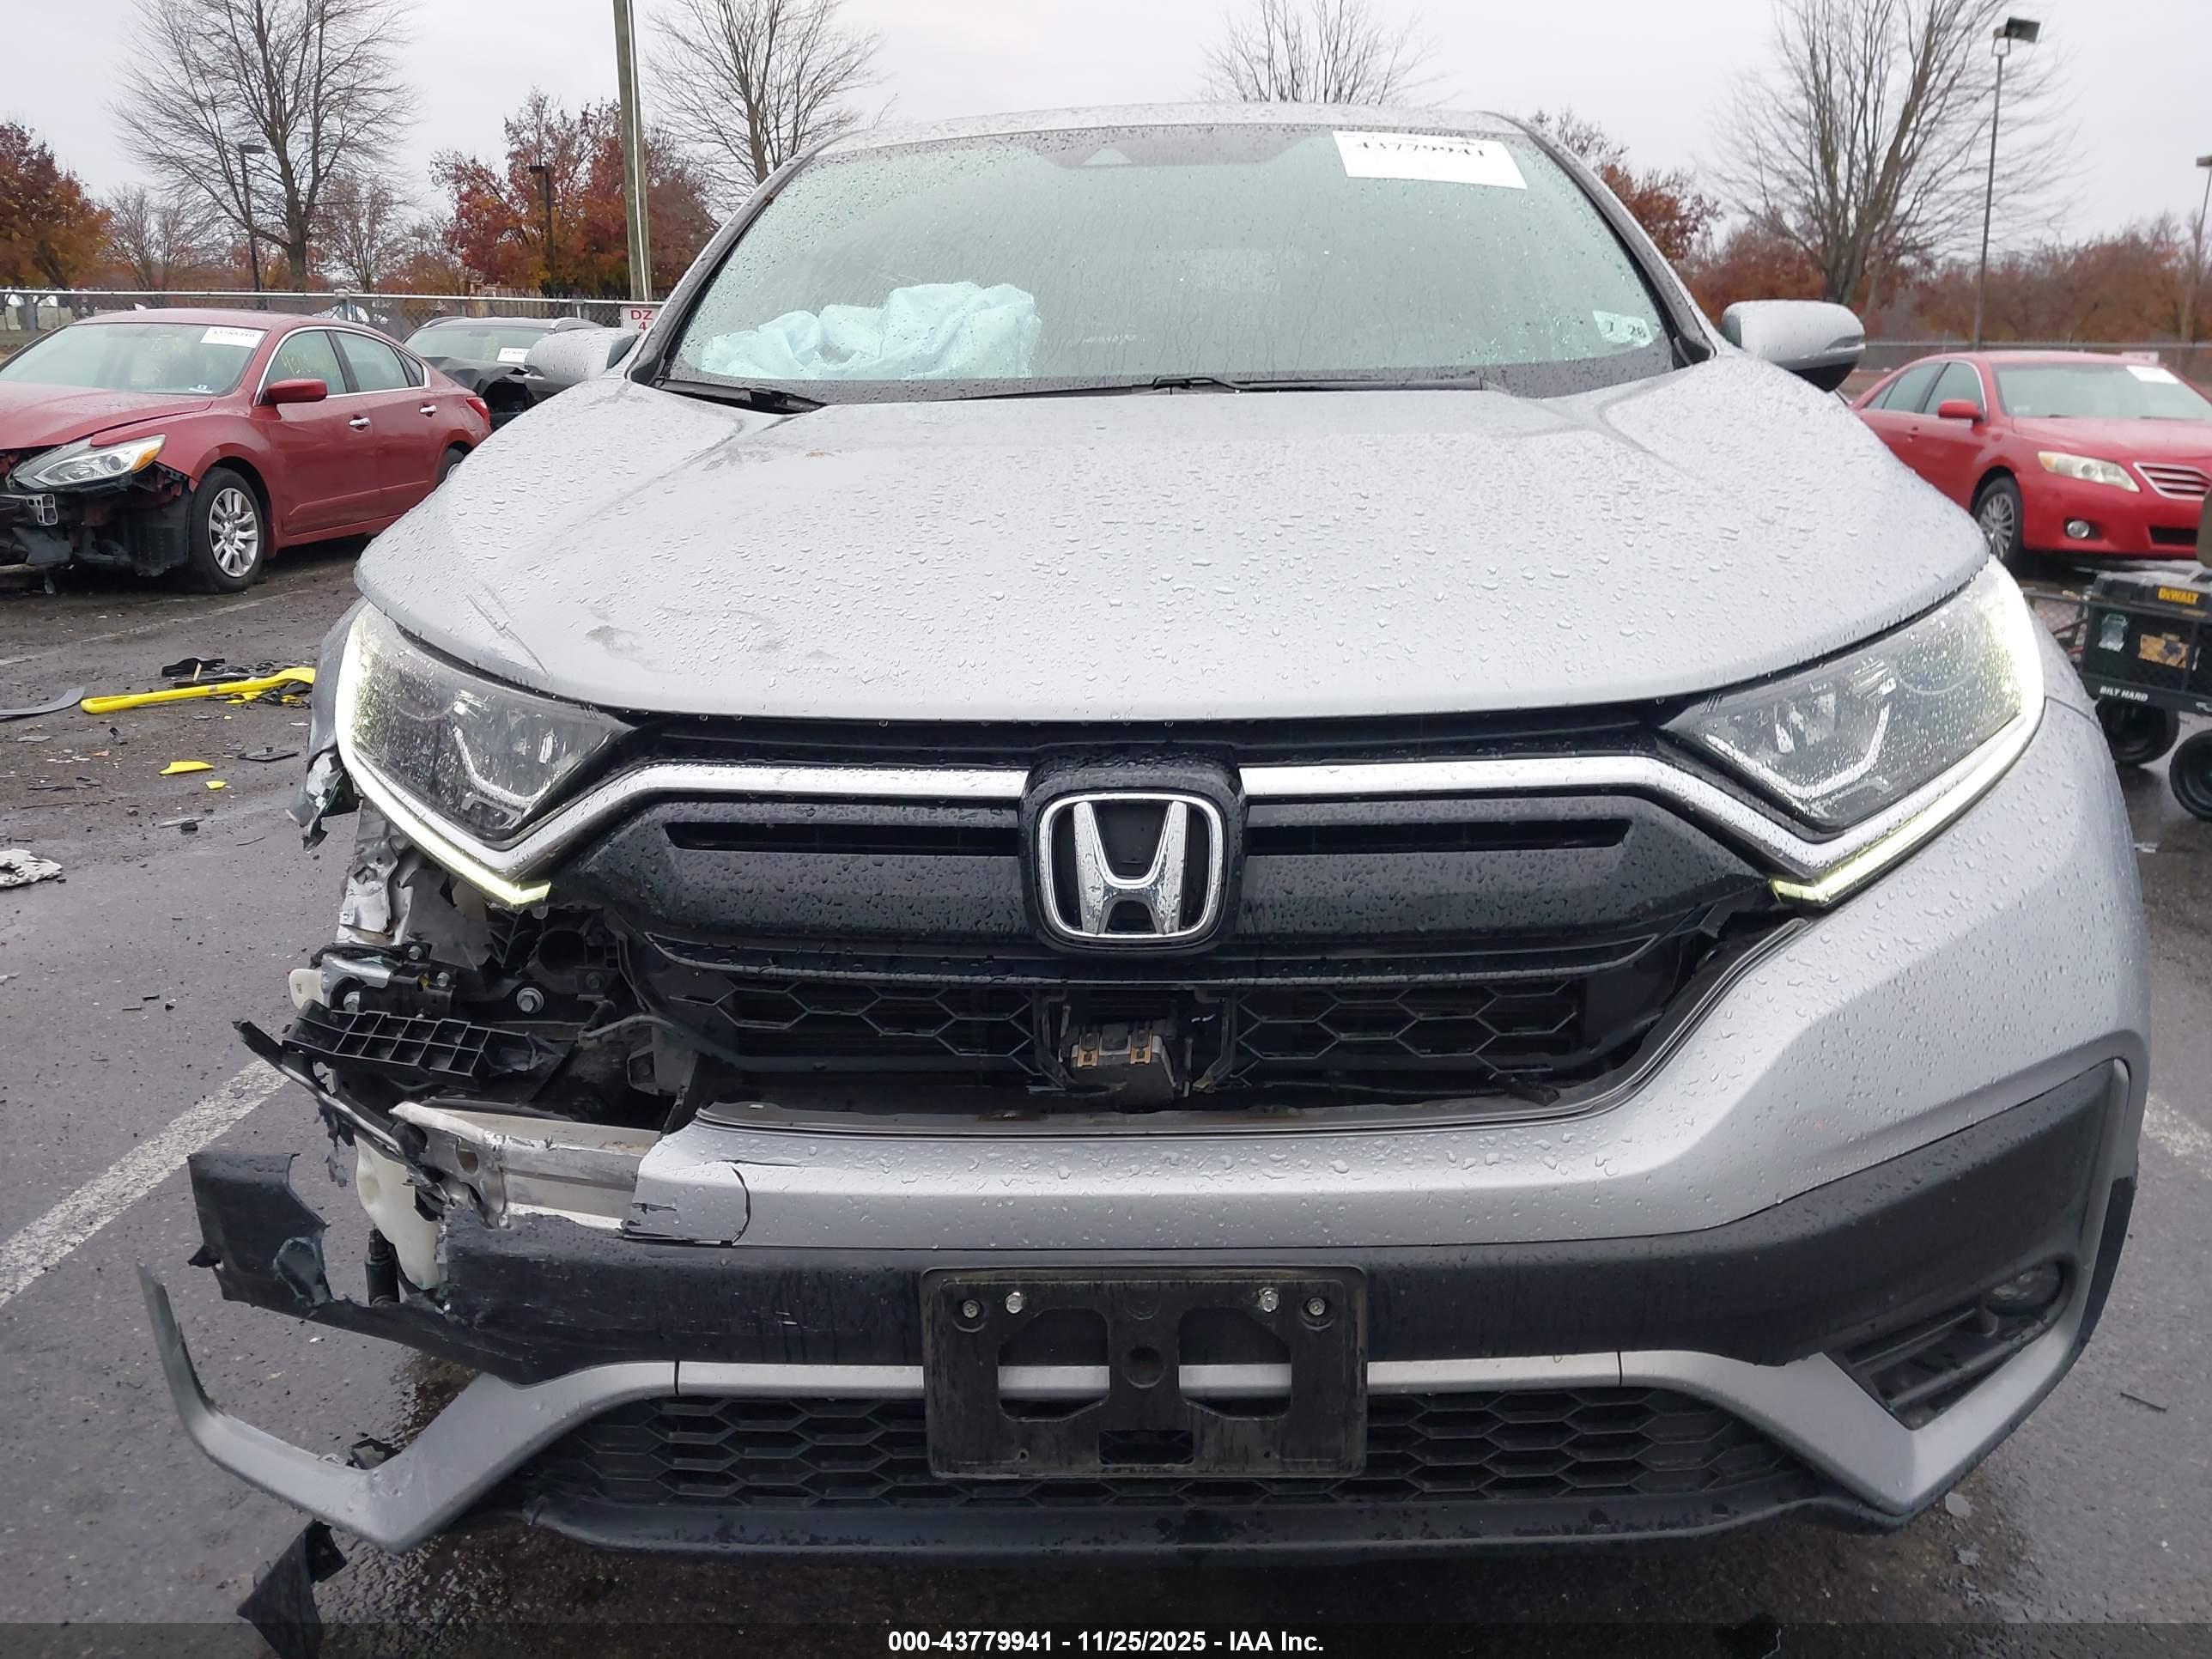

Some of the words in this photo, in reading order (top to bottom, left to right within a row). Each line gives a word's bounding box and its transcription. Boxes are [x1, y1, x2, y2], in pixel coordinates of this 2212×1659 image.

[631, 310, 653, 320] DZ
[638, 321, 647, 331] 4
[2121, 689, 2148, 702] HARD
